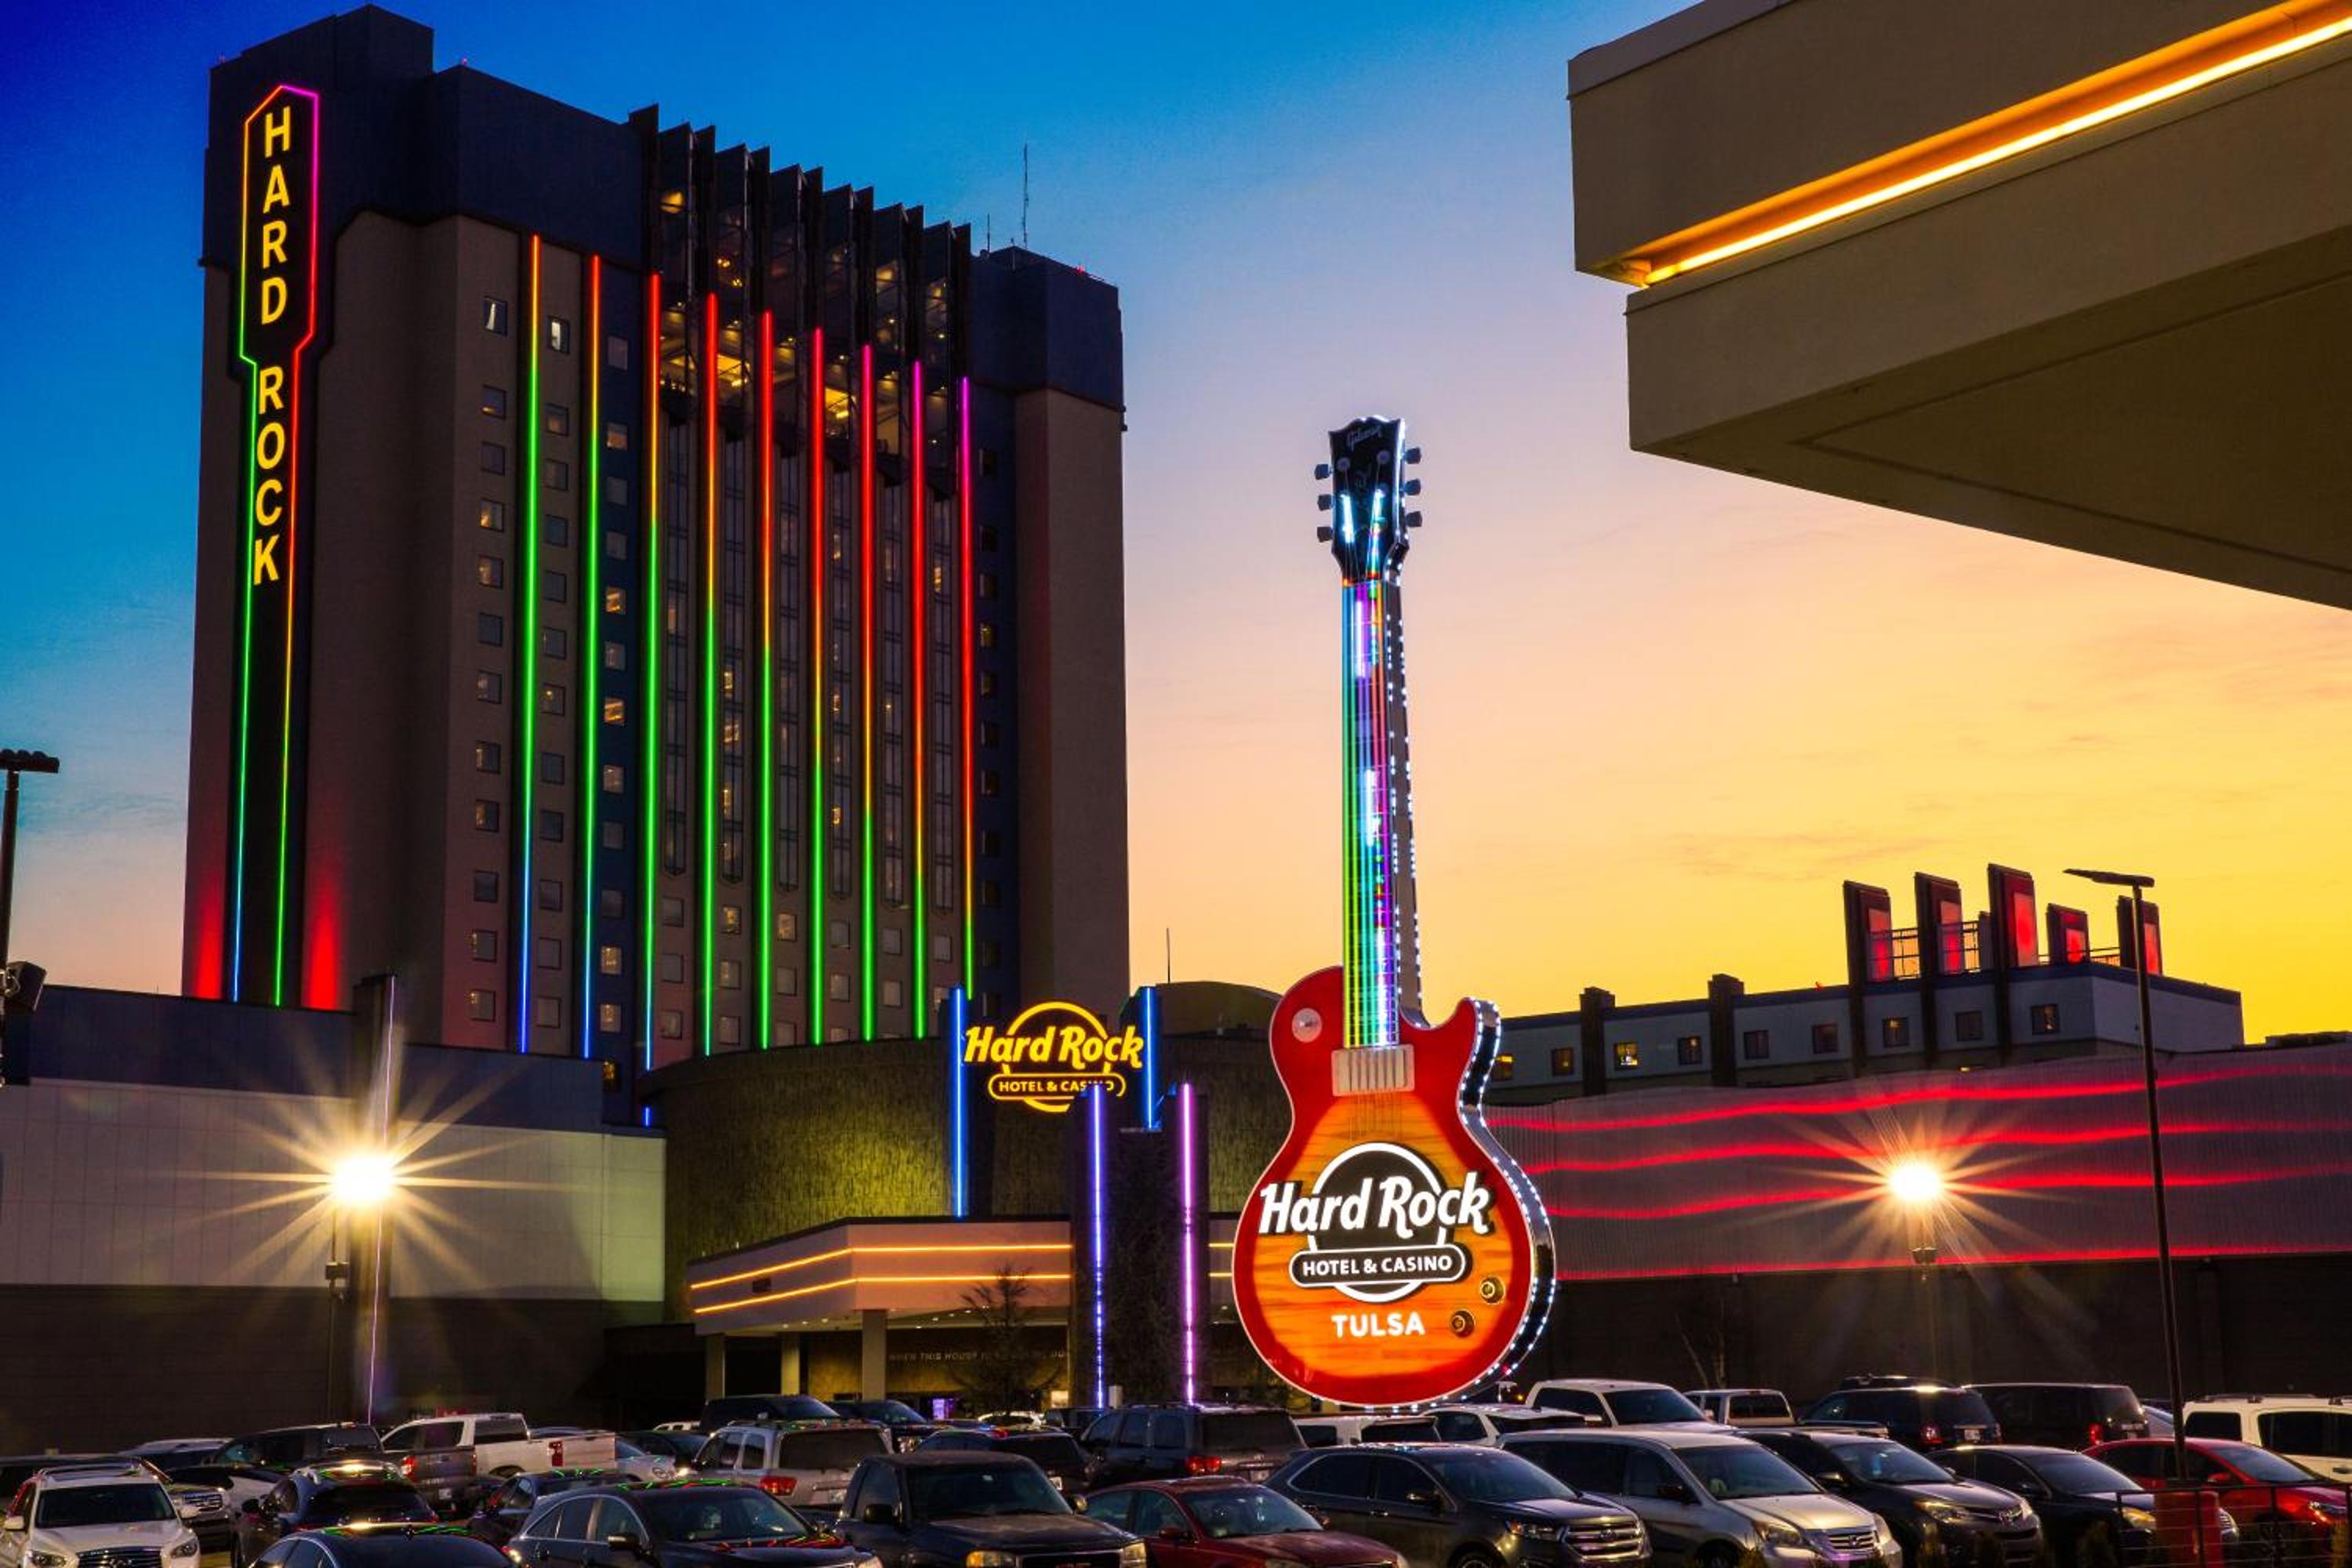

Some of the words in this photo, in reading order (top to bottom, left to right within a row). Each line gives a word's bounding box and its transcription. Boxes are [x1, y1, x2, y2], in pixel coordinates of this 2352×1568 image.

[261, 106, 291, 325] HARD
[253, 366, 285, 586] ROCK
[964, 1025, 1056, 1062] Hard
[1058, 1025, 1145, 1069] Rock
[999, 1080, 1042, 1092] HOTEL
[1047, 1080, 1058, 1092] &
[1258, 1178, 1372, 1235] Hard
[1378, 1171, 1490, 1239] Rock
[1302, 1260, 1359, 1276] HOTEL
[1363, 1258, 1377, 1274] &
[1381, 1255, 1452, 1272] CASINO
[1331, 1312, 1425, 1338] TULSA
